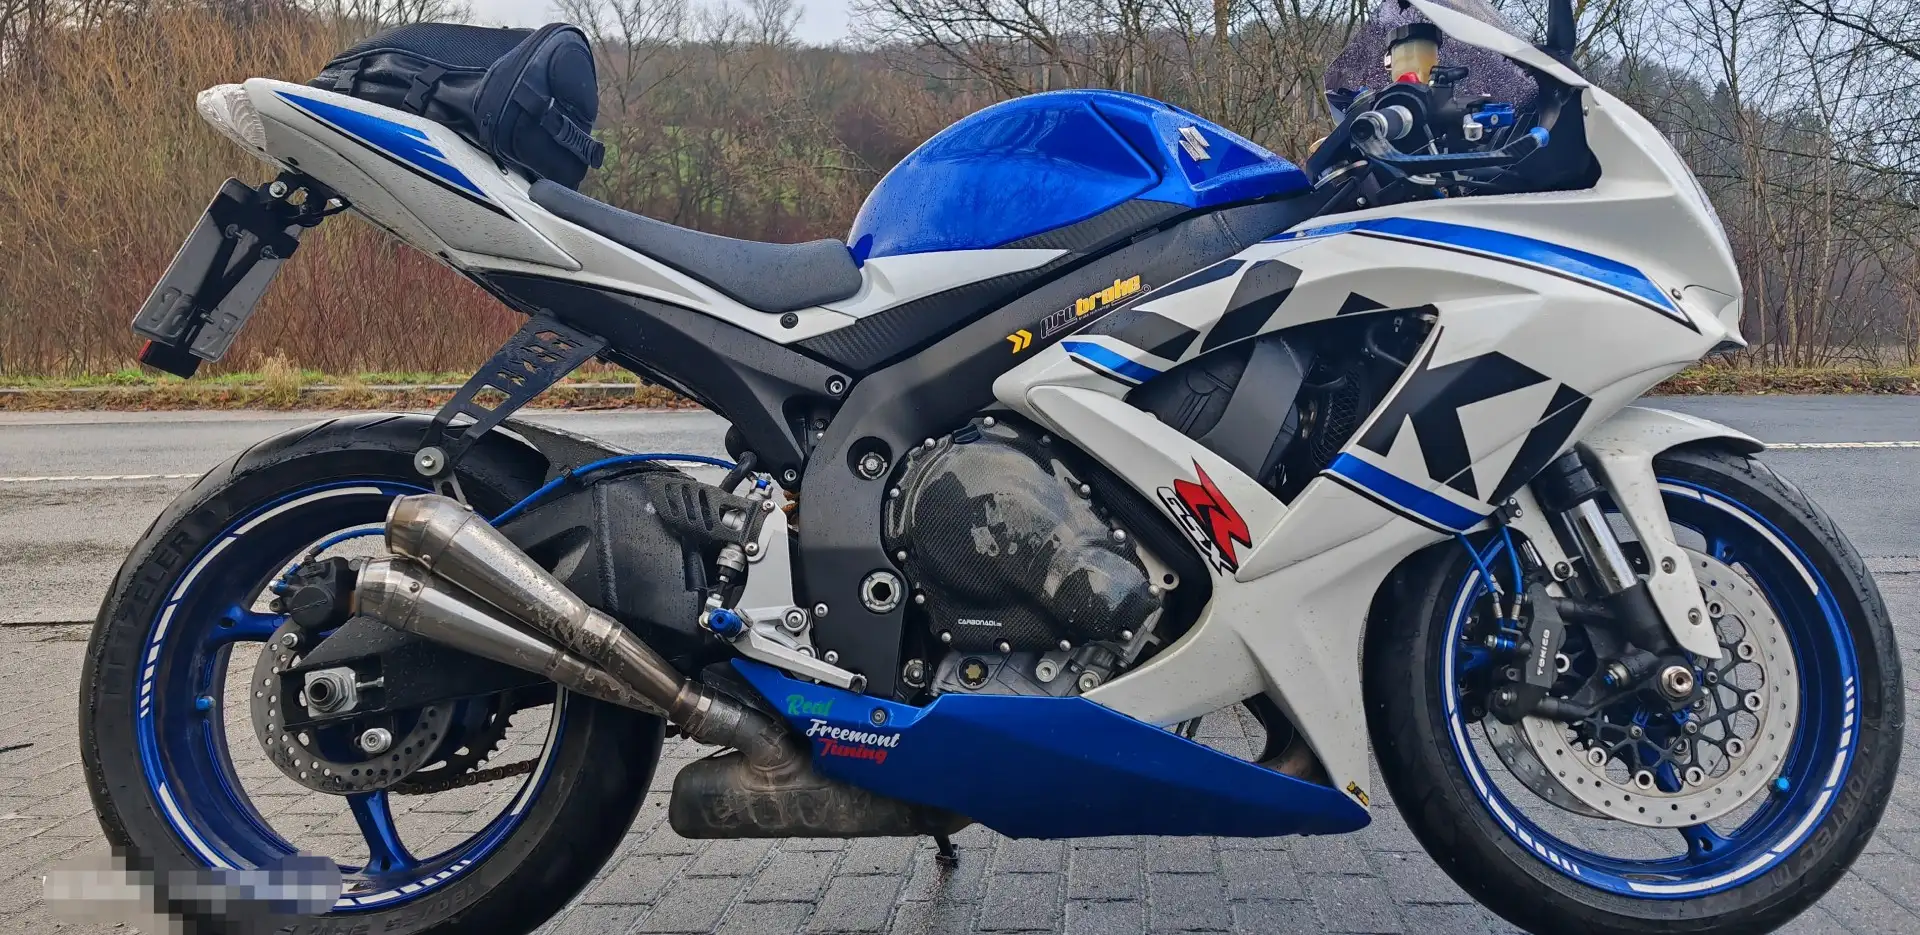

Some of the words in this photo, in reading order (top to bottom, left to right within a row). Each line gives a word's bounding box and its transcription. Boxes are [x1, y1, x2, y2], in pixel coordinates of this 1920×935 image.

[1536, 629, 1550, 676] TOKICO
[786, 694, 836, 717] Real
[806, 718, 901, 748] Freemont
[818, 738, 888, 765] Tuning
